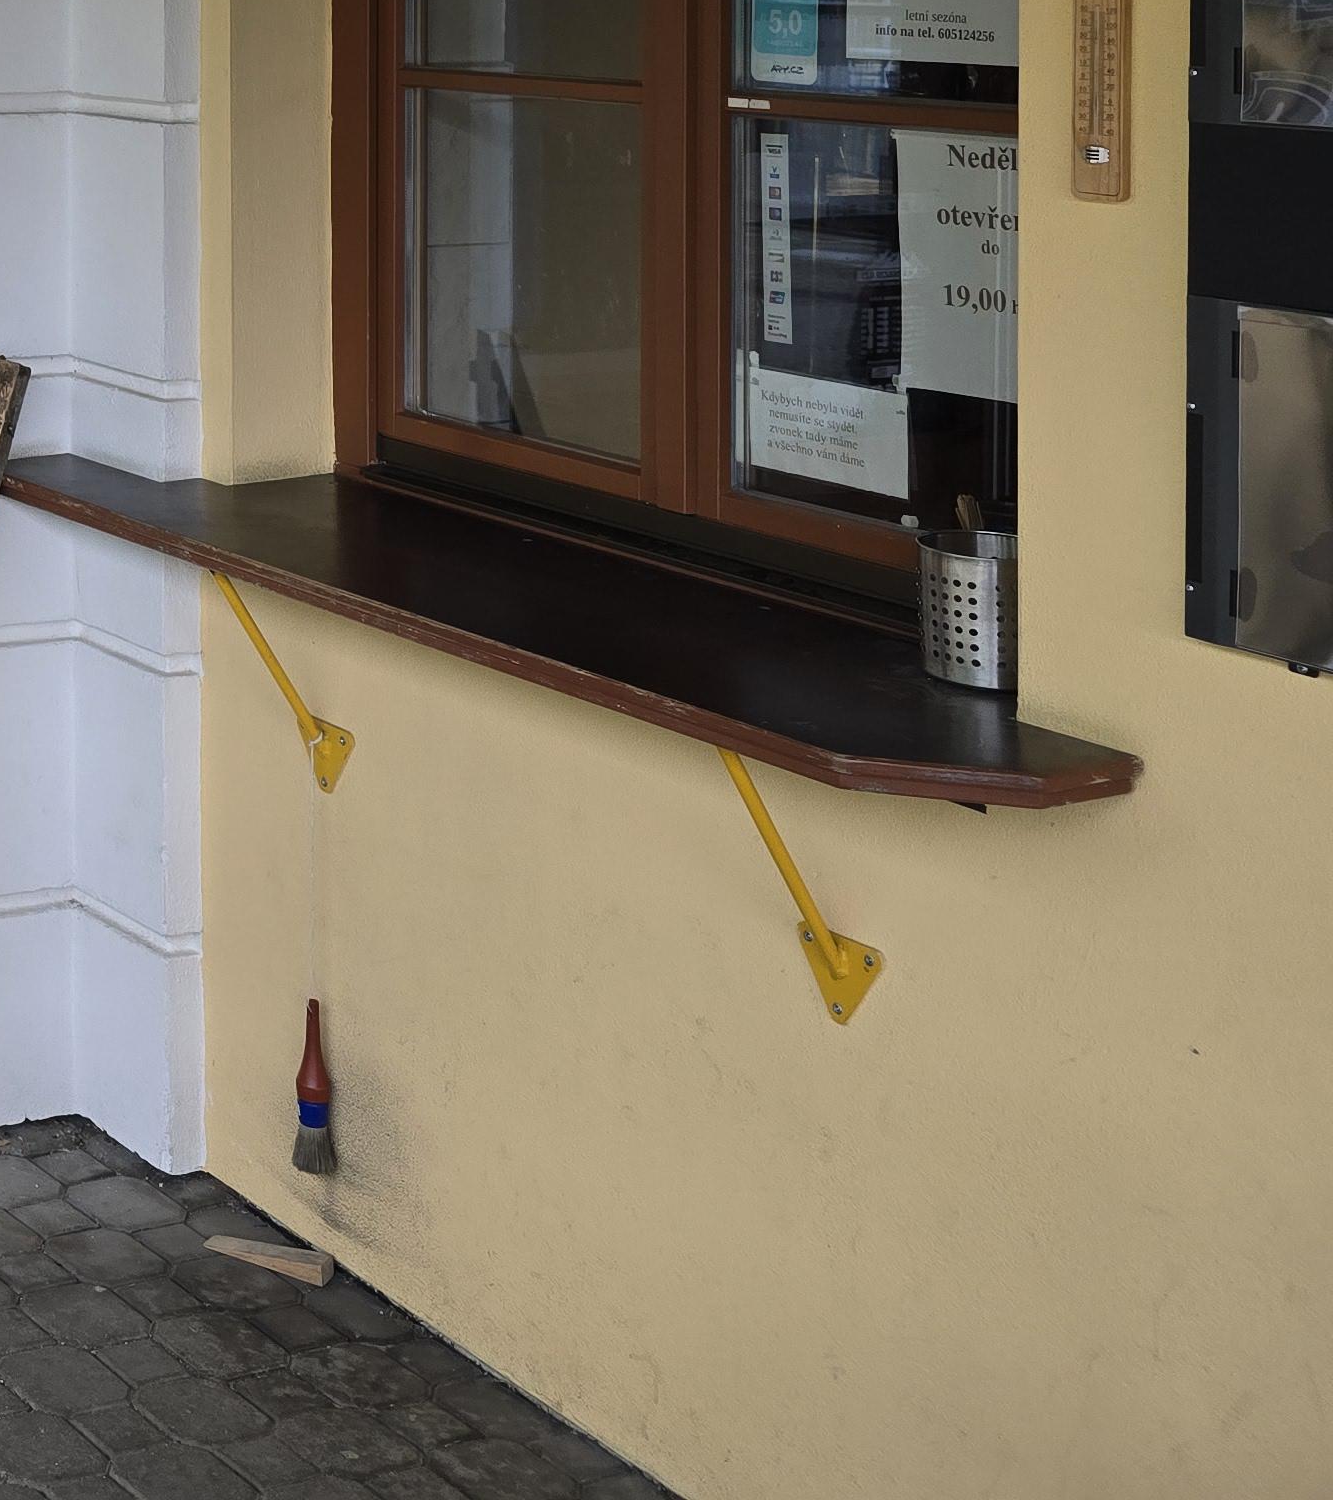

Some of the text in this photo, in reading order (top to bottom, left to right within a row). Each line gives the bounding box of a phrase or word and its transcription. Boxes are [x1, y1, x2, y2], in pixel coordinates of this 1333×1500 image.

[768, 9, 803, 38] 5,0
[905, 9, 967, 24] letní sezóna
[875, 24, 995, 42] info na tel. 605124256
[981, 239, 1000, 255] do
[942, 283, 1007, 315] 19,00
[761, 389, 803, 408] Kdybych
[805, 399, 838, 415] nebyla
[768, 408, 811, 425] nemusíte
[813, 418, 825, 428] se
[768, 423, 859, 450] zvonek tady máme
[774, 440, 814, 457] všechno
[816, 448, 838, 461] vám
[839, 453, 866, 468] dáme
